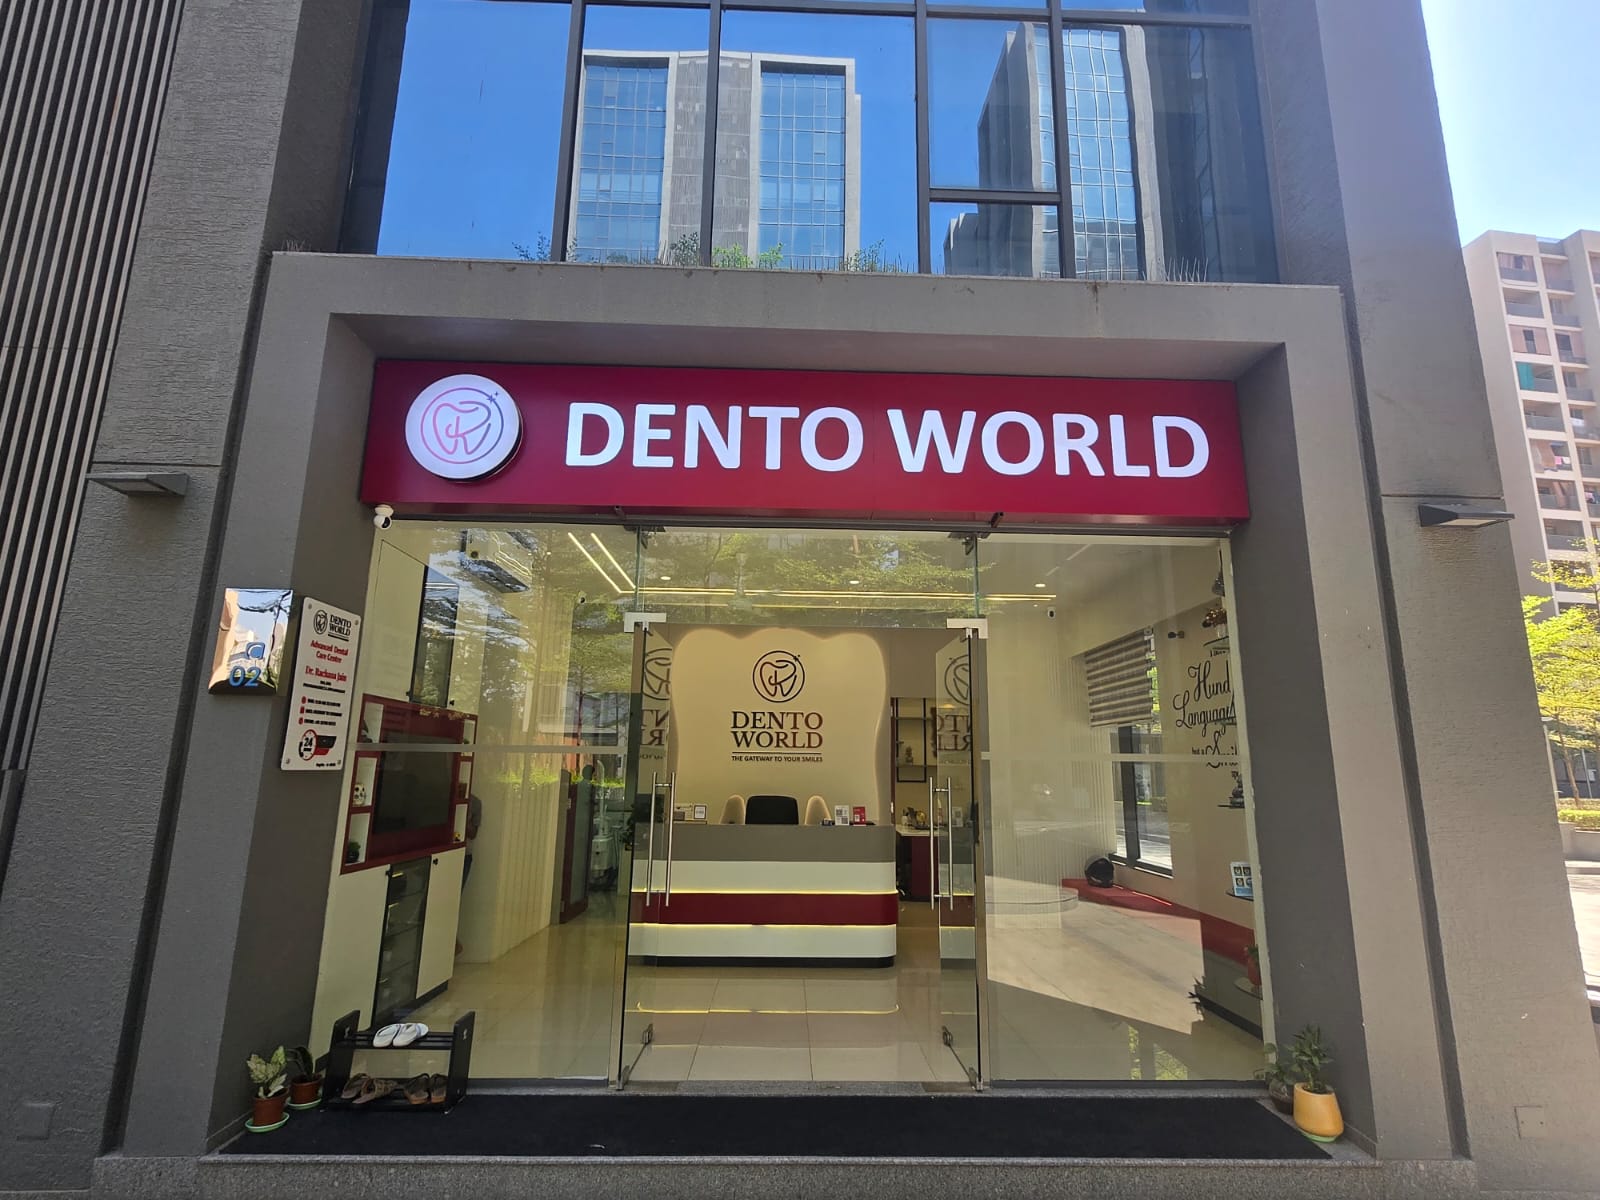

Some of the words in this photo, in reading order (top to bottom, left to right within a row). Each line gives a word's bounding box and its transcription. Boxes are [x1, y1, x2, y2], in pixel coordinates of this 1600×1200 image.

[565, 402, 864, 472] DENTO
[887, 407, 1210, 478] WORLD
[329, 614, 351, 628] DENTO
[329, 622, 351, 636] WORLD
[334, 645, 348, 656] Dental
[229, 665, 261, 687] 02
[731, 711, 823, 730] DENTO
[303, 737, 313, 747] 24
[731, 731, 823, 748] WORLD
